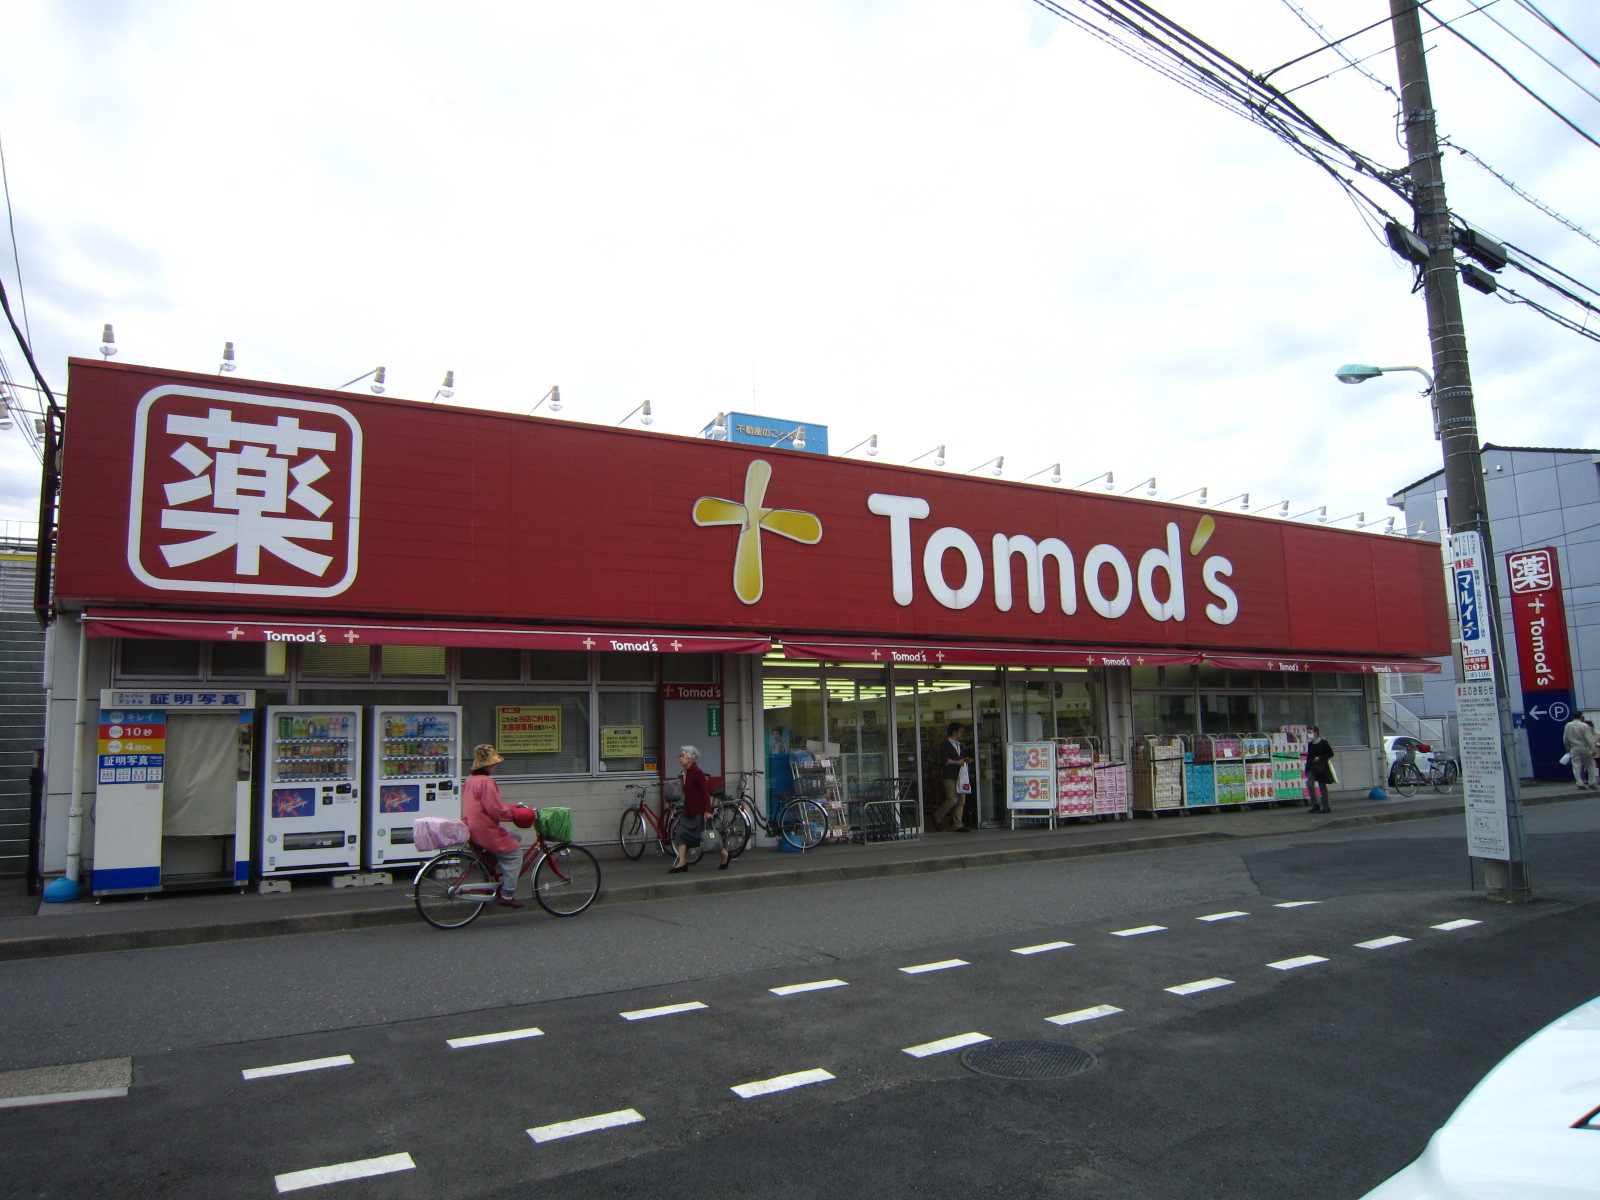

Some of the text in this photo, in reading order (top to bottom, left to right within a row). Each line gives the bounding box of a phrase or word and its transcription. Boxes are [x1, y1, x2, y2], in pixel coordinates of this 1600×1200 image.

[159, 408, 337, 578] 薬
[867, 493, 1239, 625] Tomod's
[1511, 555, 1551, 590] 薬
[1458, 574, 1477, 638] マルイチ
[263, 629, 327, 643] Tomod's
[610, 639, 658, 652] Tomod's
[1530, 617, 1554, 686] Tomod's
[891, 650, 927, 662] Tomod's
[1101, 656, 1131, 666] Tomod's
[677, 686, 722, 698] Tomod's
[150, 693, 240, 705] 証明写真
[127, 712, 154, 722] キレイ
[104, 756, 149, 766] 証明写真
